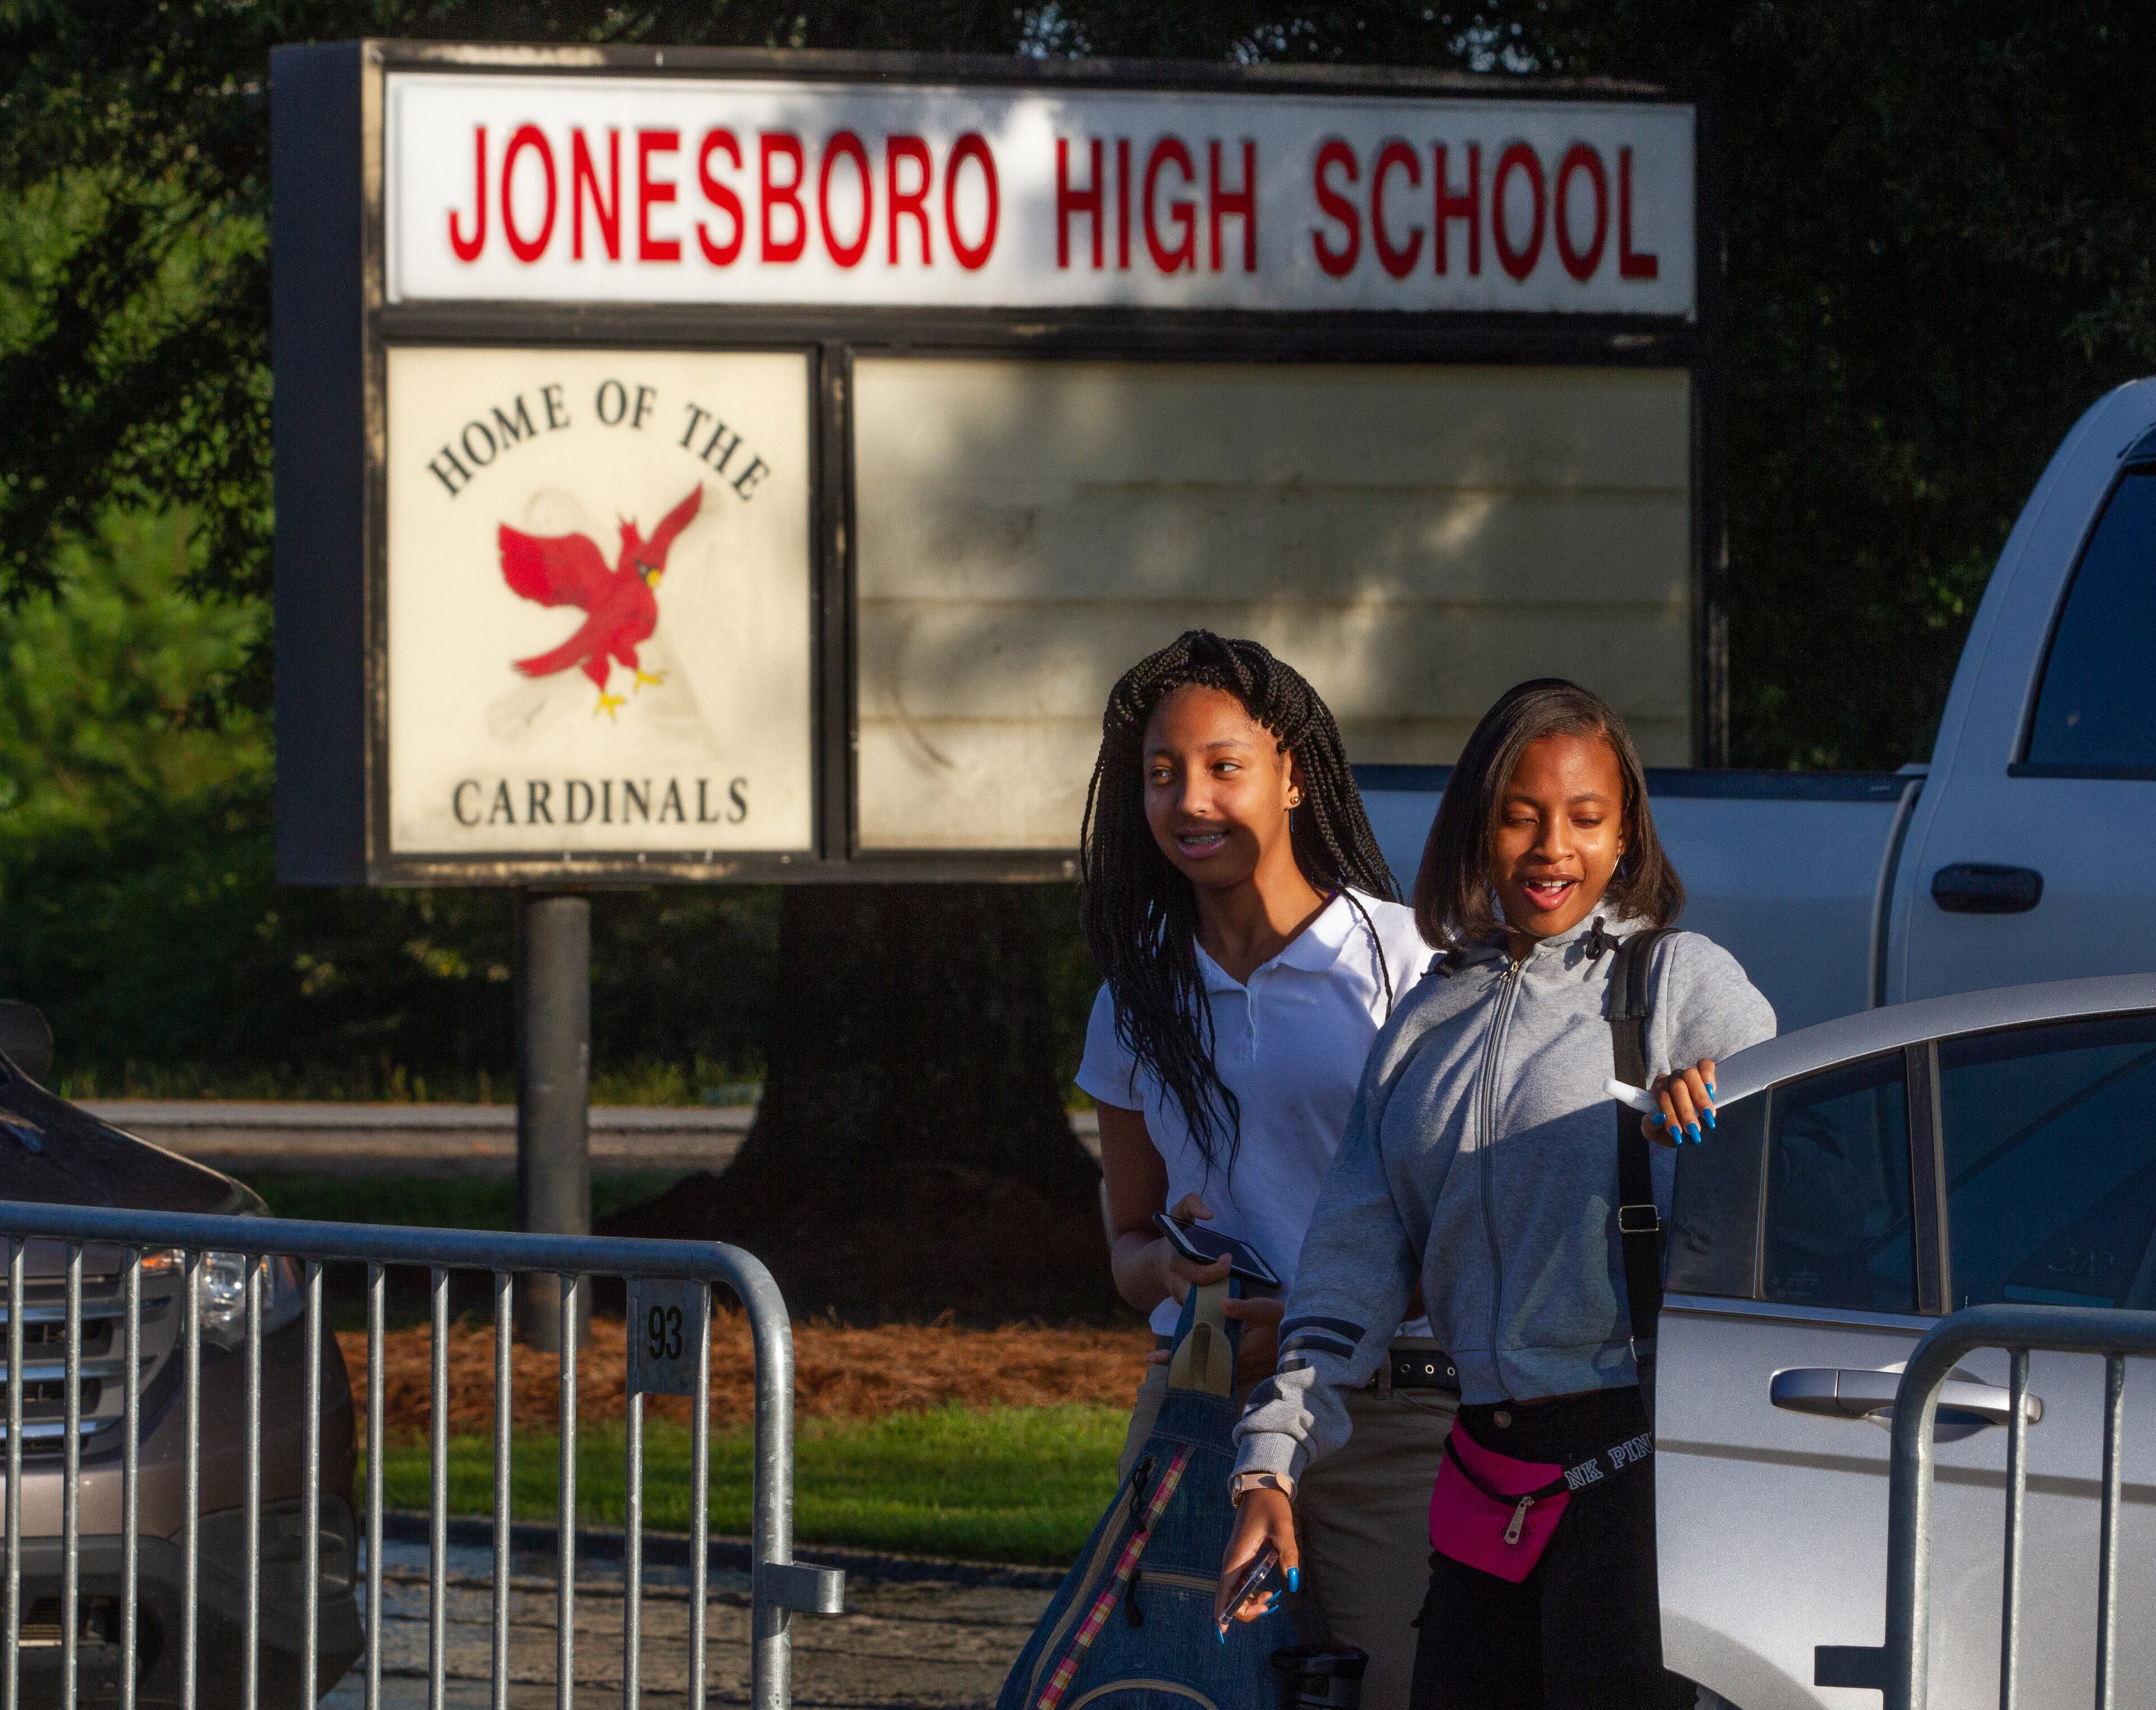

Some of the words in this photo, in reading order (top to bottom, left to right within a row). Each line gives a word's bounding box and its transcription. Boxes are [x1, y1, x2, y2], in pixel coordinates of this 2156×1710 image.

[447, 122, 1002, 273] JONESBORO
[1055, 136, 1257, 275] HIGH
[1312, 138, 1659, 279] SCHOOL
[427, 383, 570, 497] HOME
[595, 379, 657, 429] OF
[679, 403, 770, 502] THE
[453, 778, 748, 827] CARDINALS
[648, 1306, 682, 1360] 93
